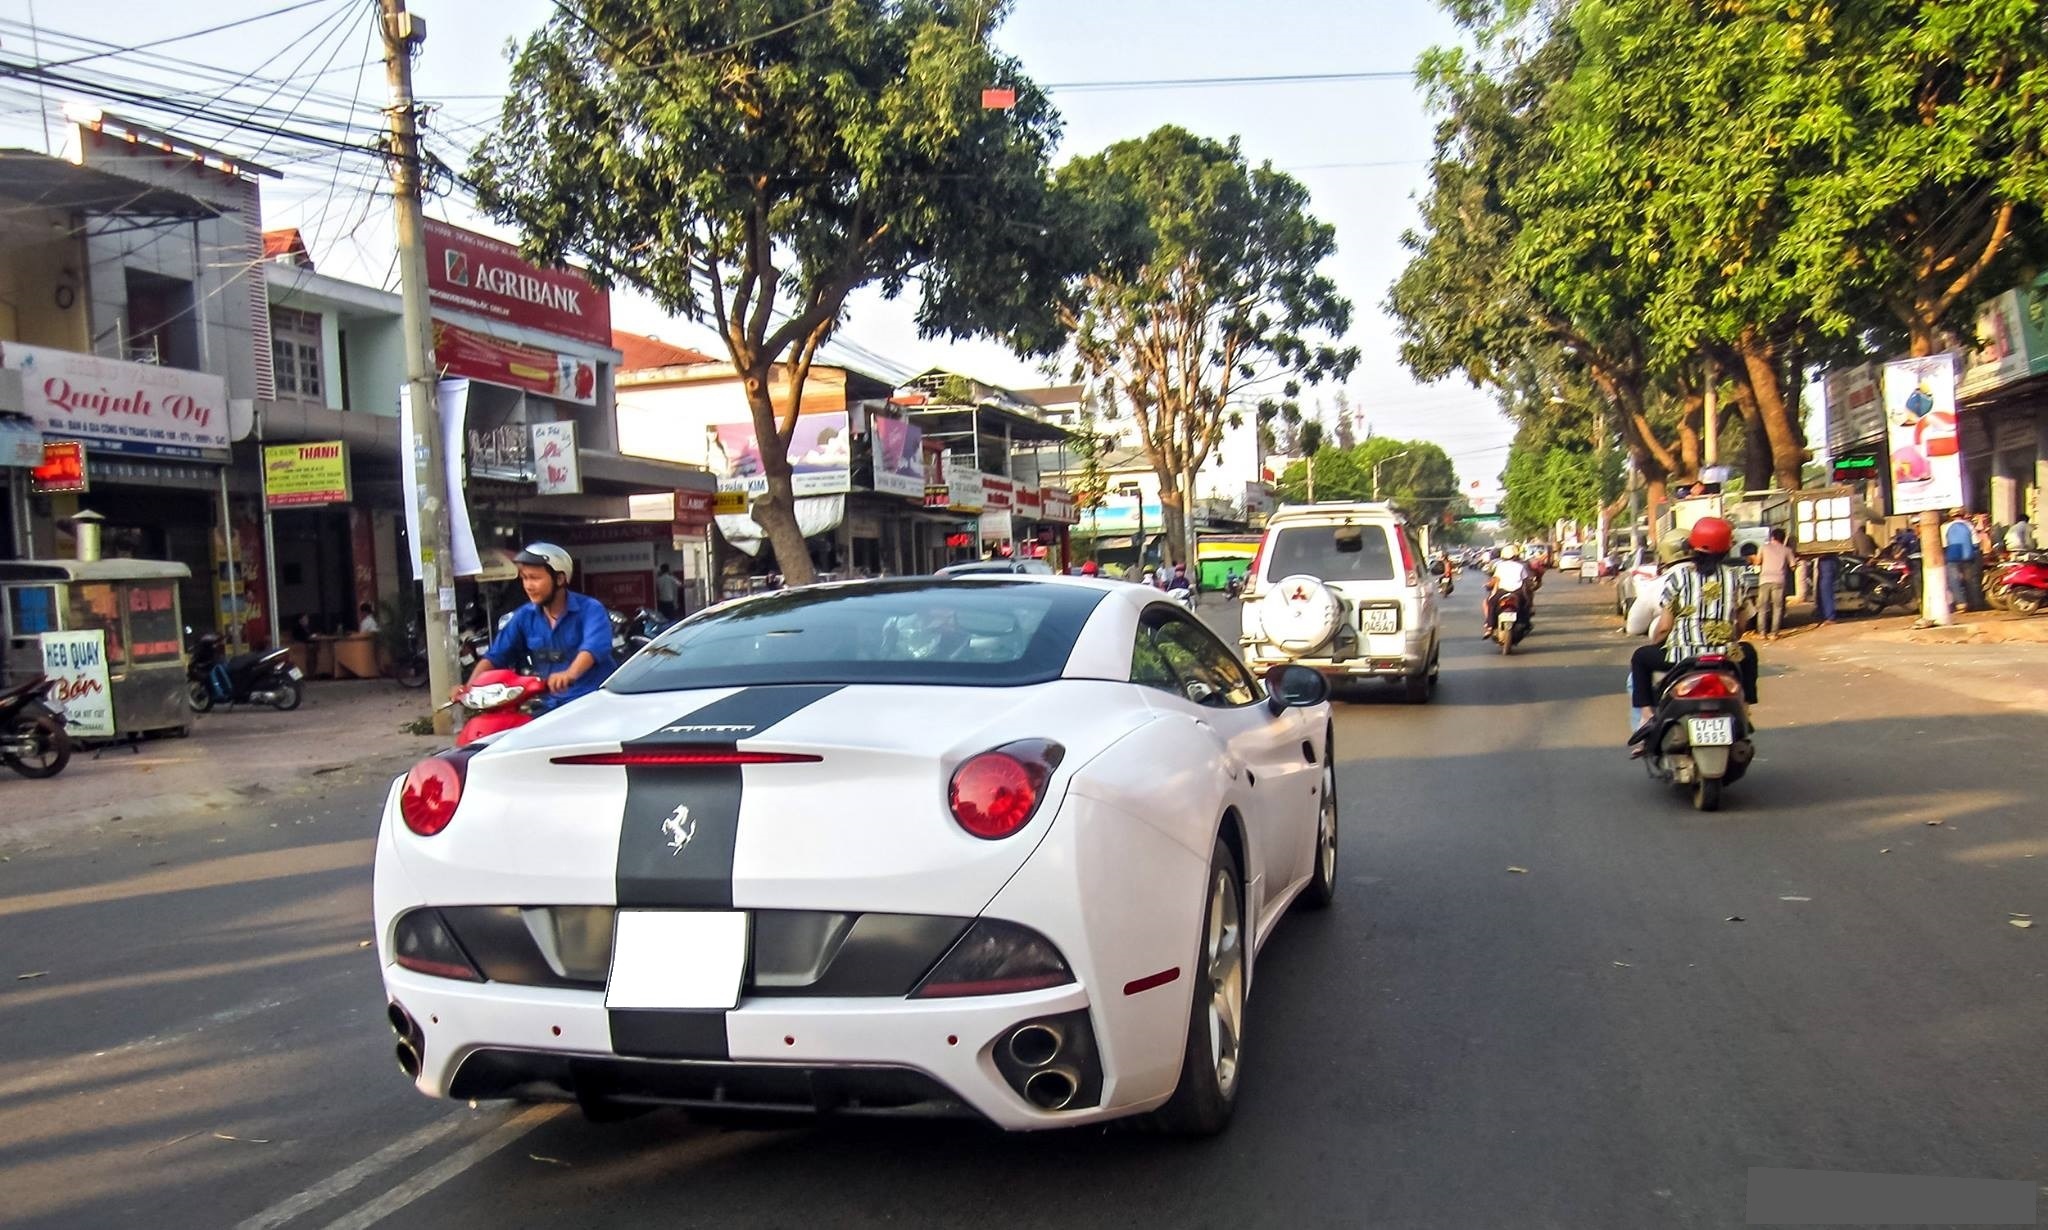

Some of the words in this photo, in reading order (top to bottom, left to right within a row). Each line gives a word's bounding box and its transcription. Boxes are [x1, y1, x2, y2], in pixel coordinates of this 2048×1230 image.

[475, 263, 582, 316] AGRIBANK
[44, 377, 152, 416] Quỳnh
[298, 445, 339, 460] THANH
[70, 642, 99, 670] QUAY
